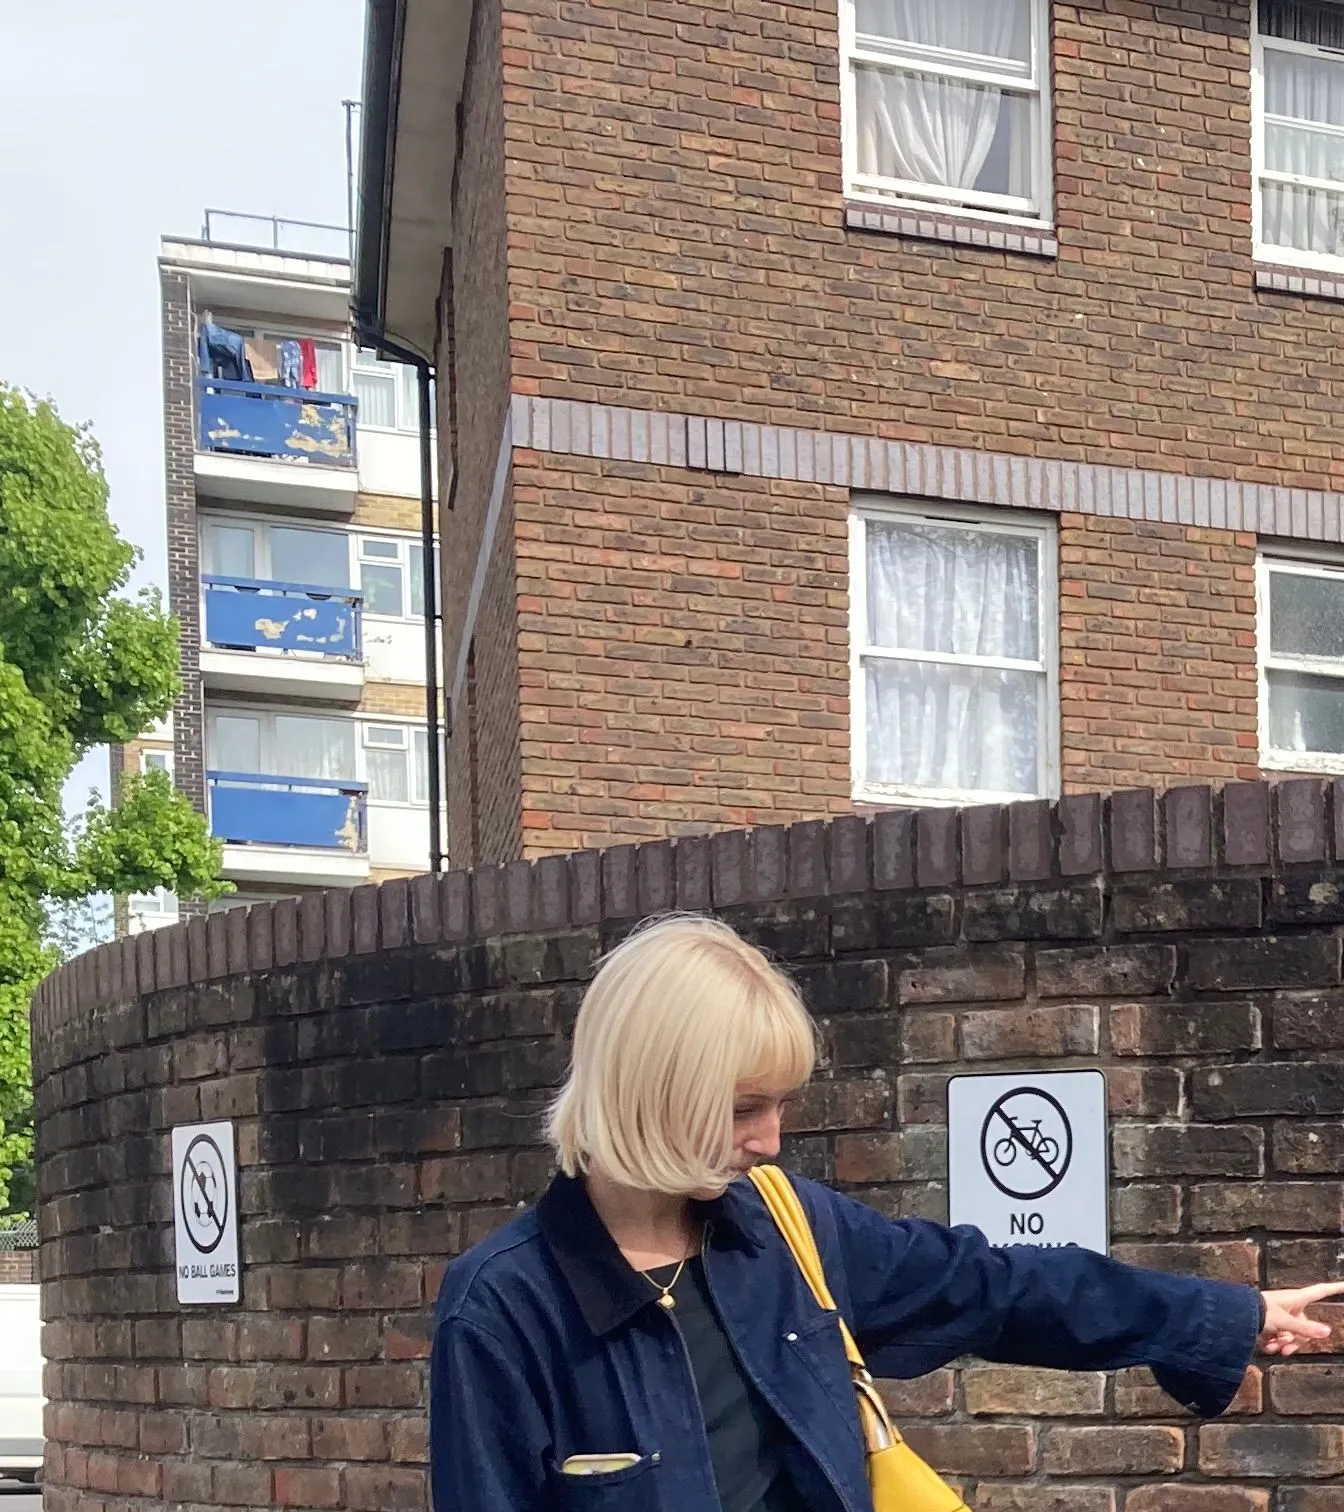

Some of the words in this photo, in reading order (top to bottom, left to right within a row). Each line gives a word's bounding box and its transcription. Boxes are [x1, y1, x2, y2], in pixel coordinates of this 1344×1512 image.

[1010, 1212, 1044, 1235] NO
[179, 1265, 189, 1278] NO
[191, 1264, 208, 1278] BALL
[210, 1263, 236, 1278] GAMES
